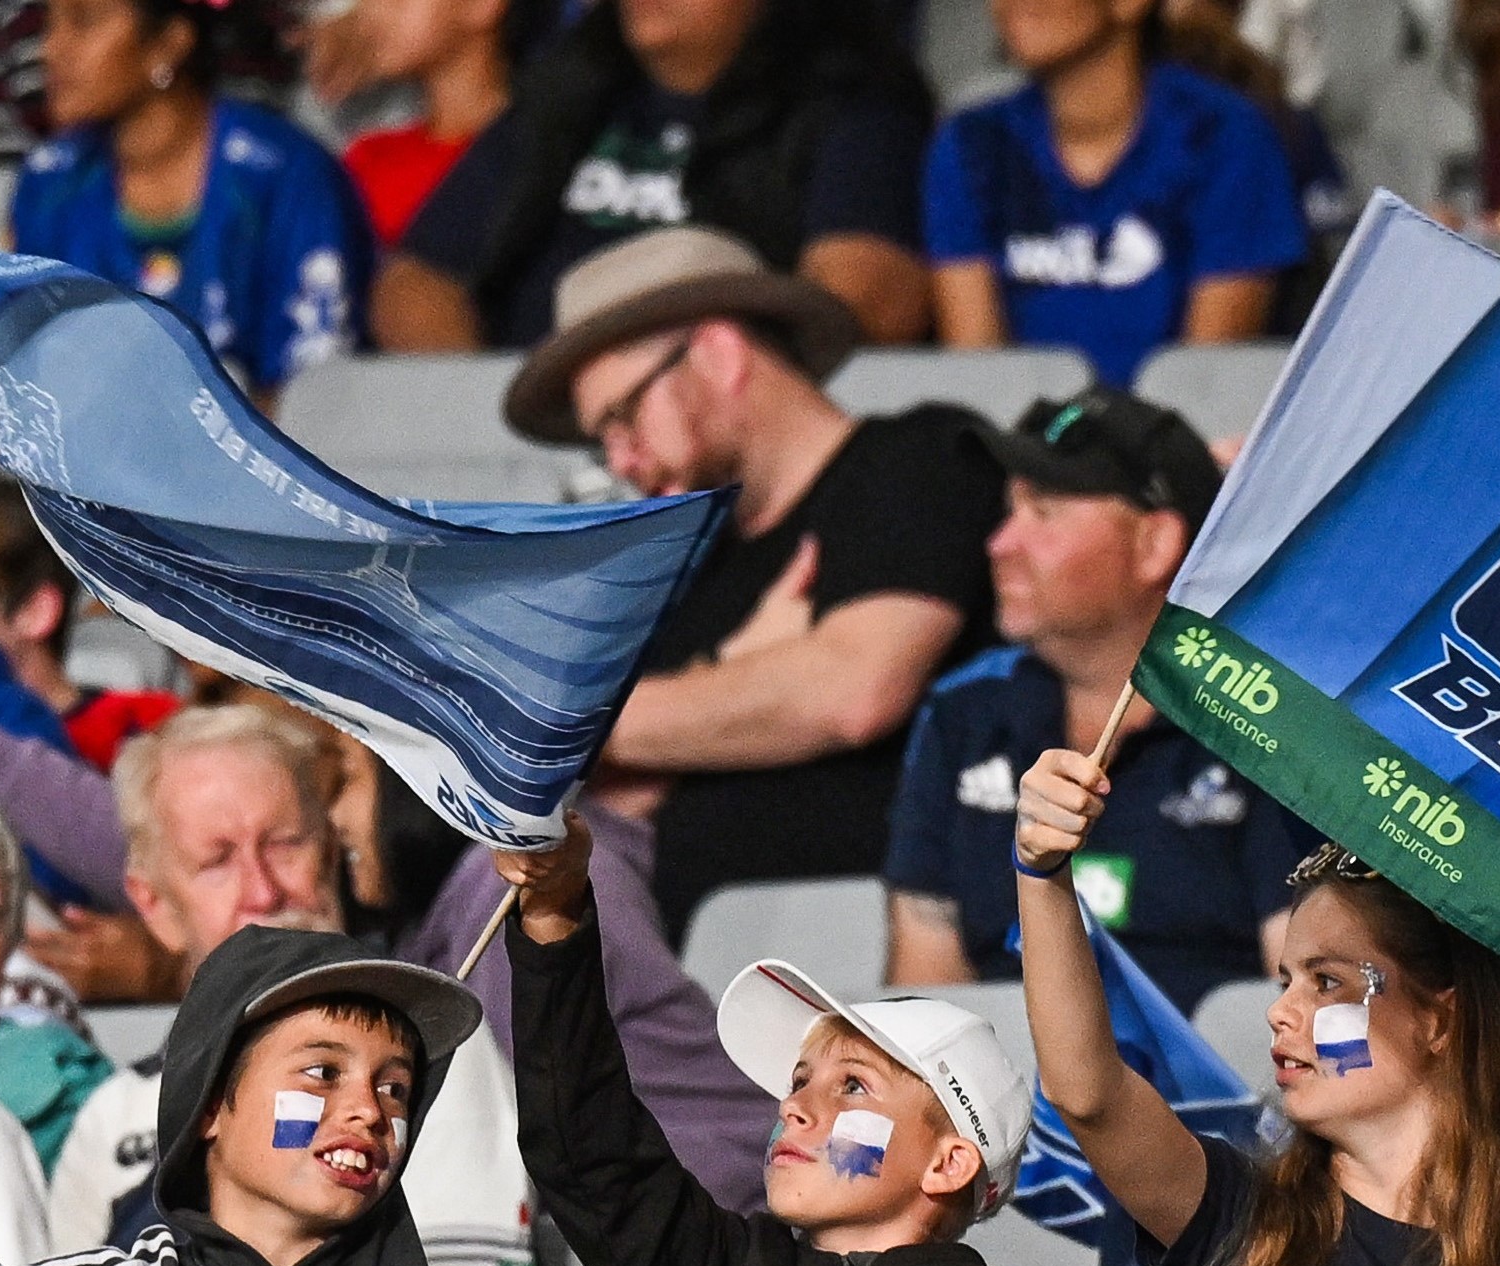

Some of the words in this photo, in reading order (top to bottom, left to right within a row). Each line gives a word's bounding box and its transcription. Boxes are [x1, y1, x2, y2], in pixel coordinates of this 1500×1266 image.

[1205, 652, 1279, 715] nib
[1194, 685, 1279, 754] Insurance
[1392, 783, 1466, 847] nib
[1378, 815, 1464, 884] Insurance
